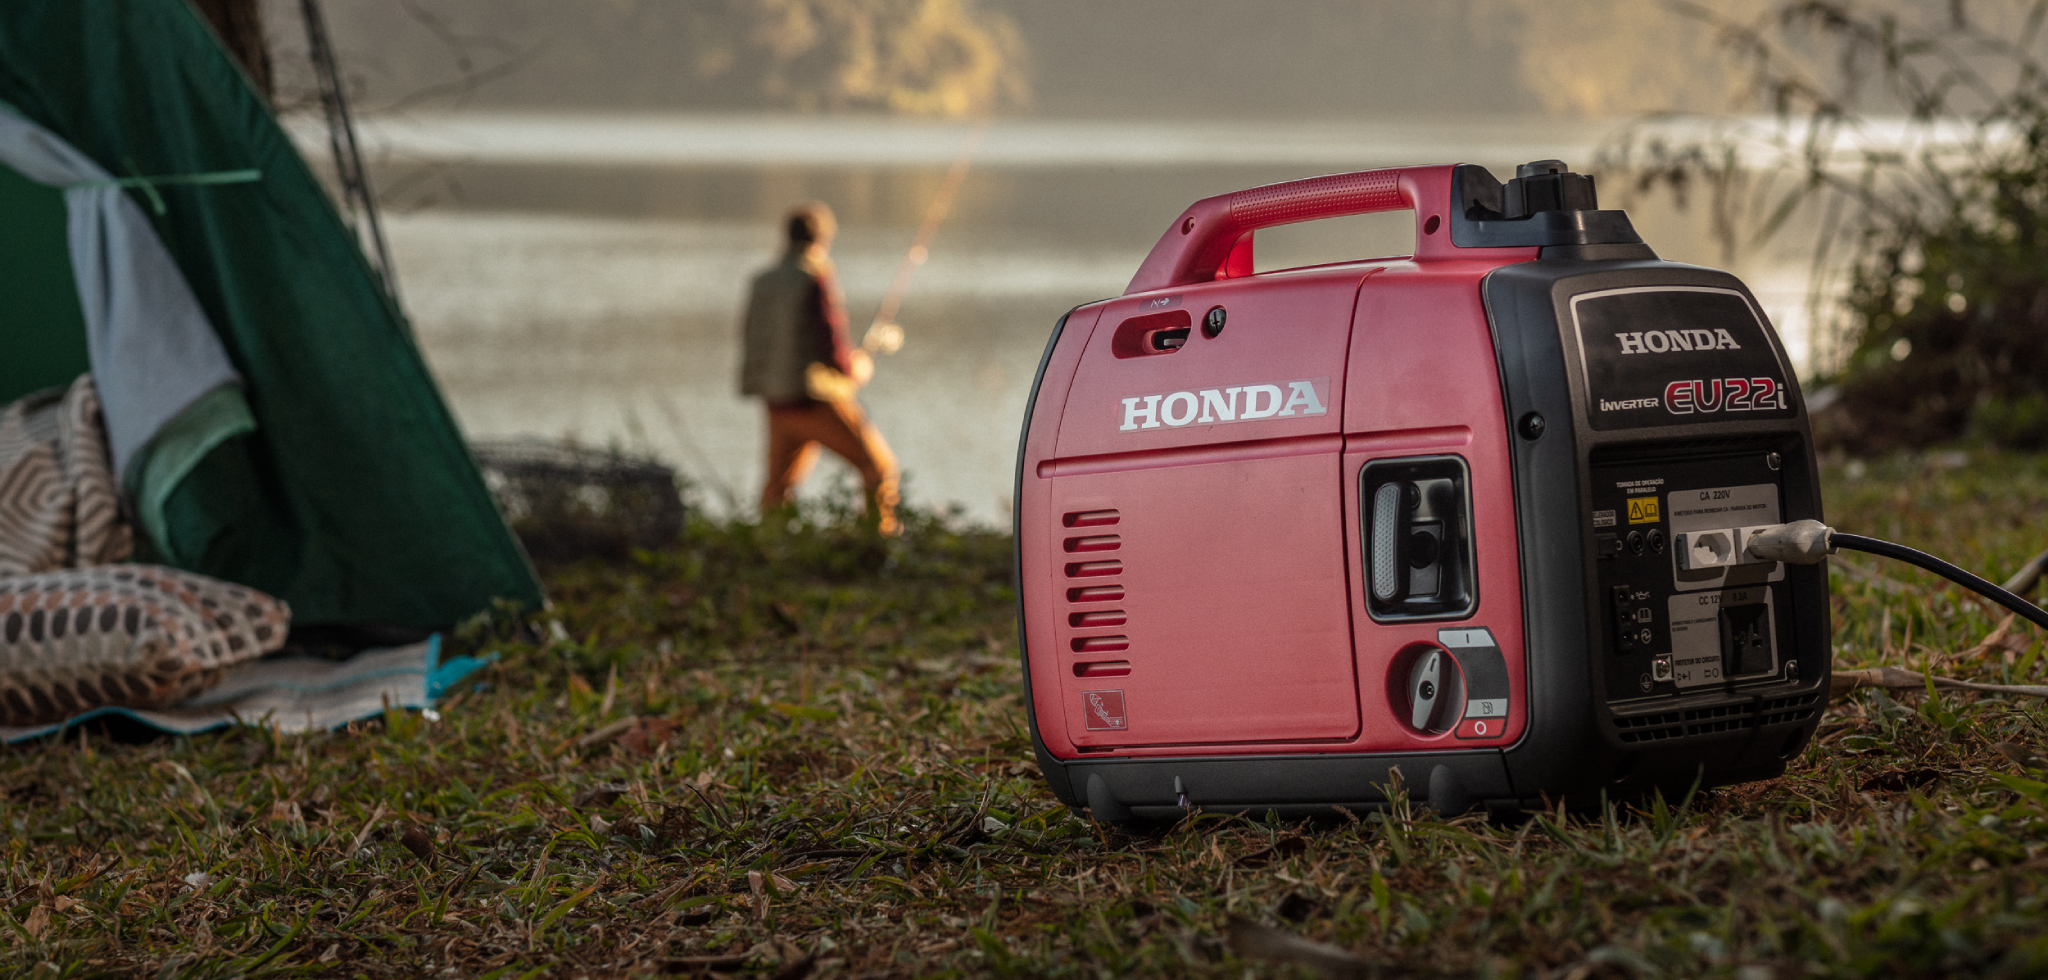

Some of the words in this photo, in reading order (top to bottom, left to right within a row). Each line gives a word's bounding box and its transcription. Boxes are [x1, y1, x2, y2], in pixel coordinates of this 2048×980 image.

[1616, 328, 1741, 355] HONDA
[1120, 381, 1326, 431] HONDA
[1664, 377, 1787, 415] EU22i
[1700, 491, 1710, 501] CA
[1713, 489, 1731, 500] 220V
[1699, 595, 1709, 605] CC
[1710, 593, 1723, 604] 12V
